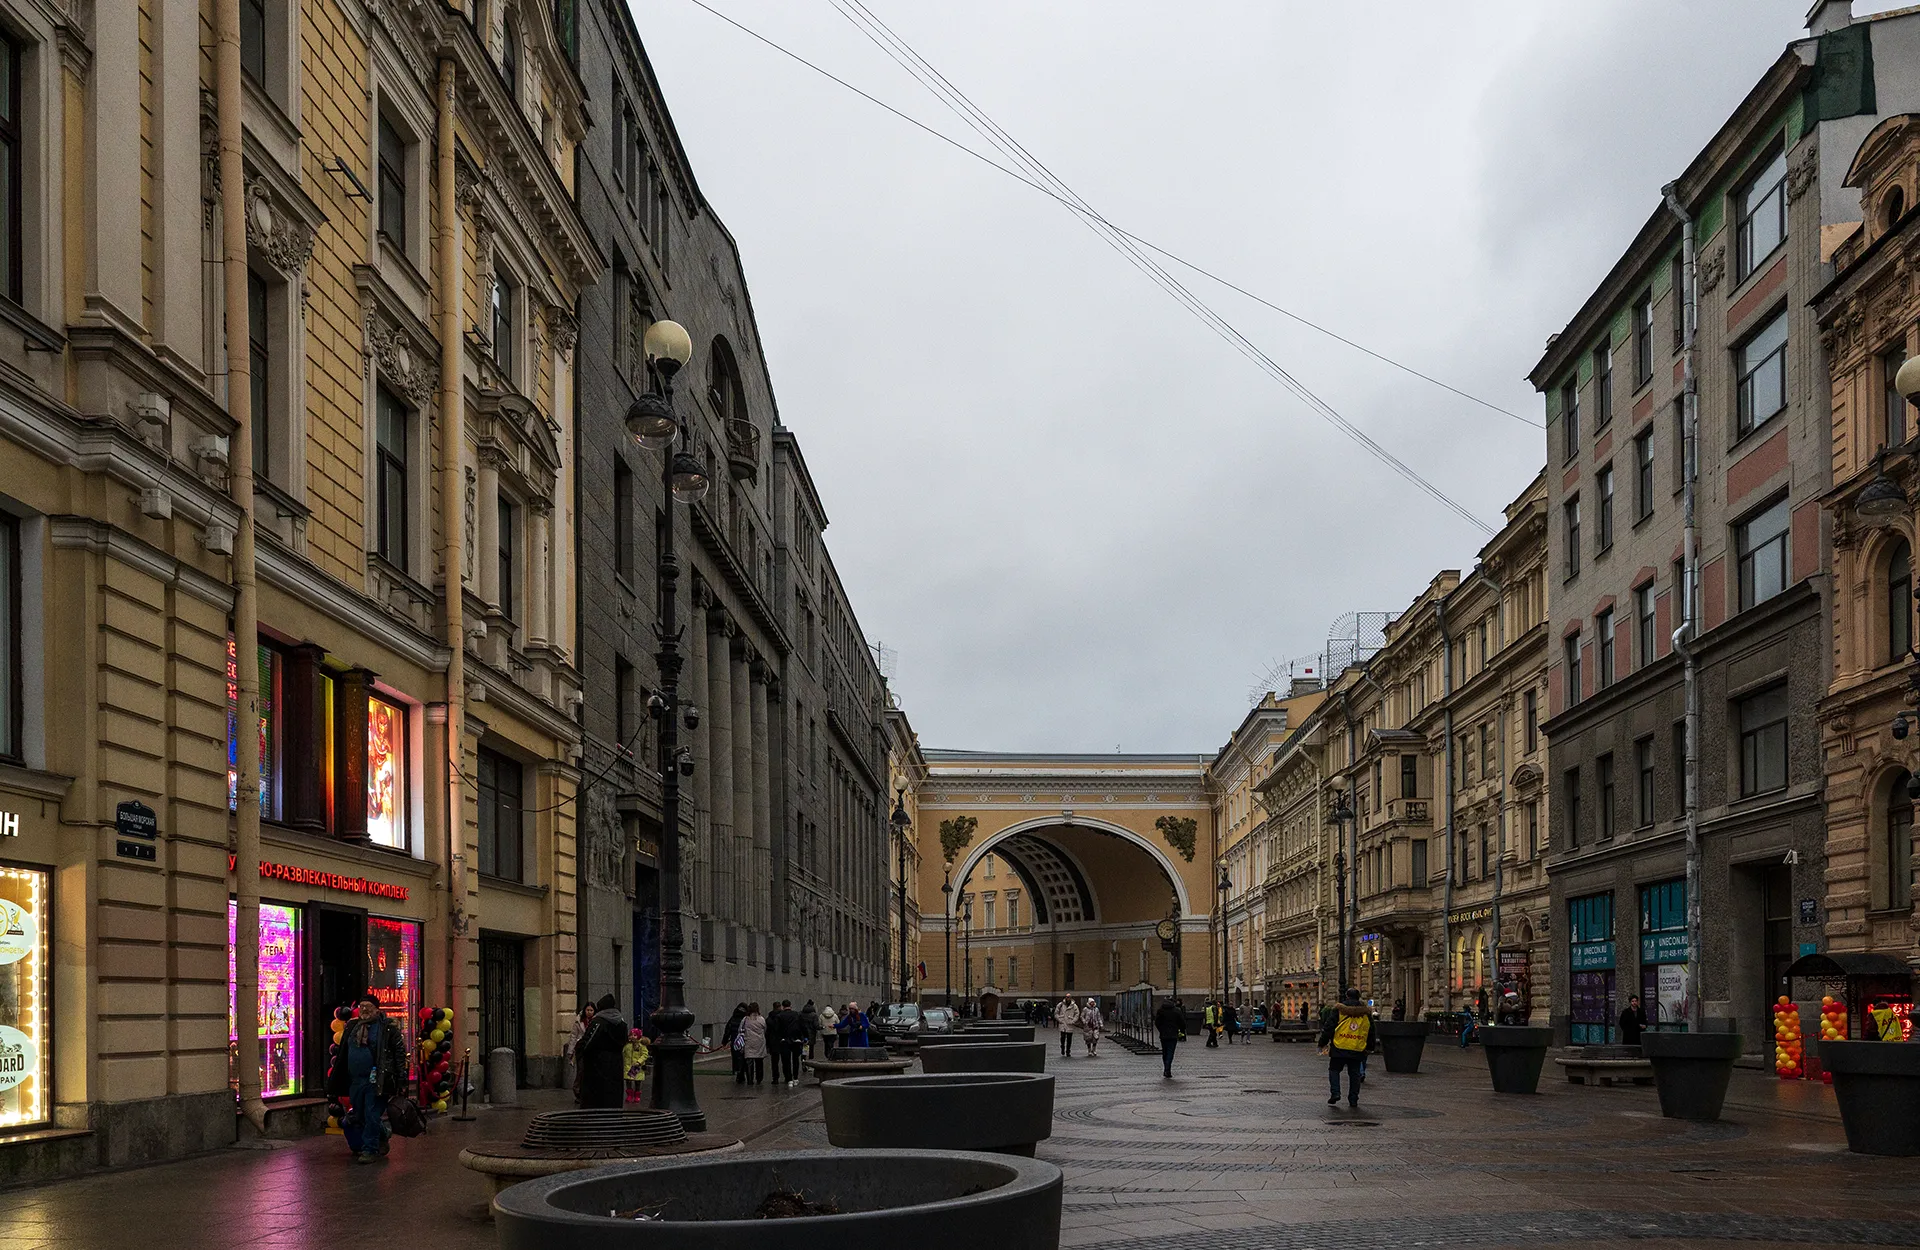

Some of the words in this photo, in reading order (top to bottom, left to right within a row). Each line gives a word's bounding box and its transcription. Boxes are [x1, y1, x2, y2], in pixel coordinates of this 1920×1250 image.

[0, 811, 19, 837] Н
[120, 811, 138, 823] БОЛЬШАЯ
[138, 815, 155, 826] МОРСКАЯ
[135, 846, 140, 856] 7
[367, 882, 410, 901] КОМПЛЕКС
[1658, 935, 1688, 947] UNECON.RU
[0, 947, 25, 955] ОНФЕТЫ
[265, 945, 284, 956] ТЕЛА
[1583, 944, 1607, 956] UNECON.RU
[0, 1053, 24, 1073] ARD
